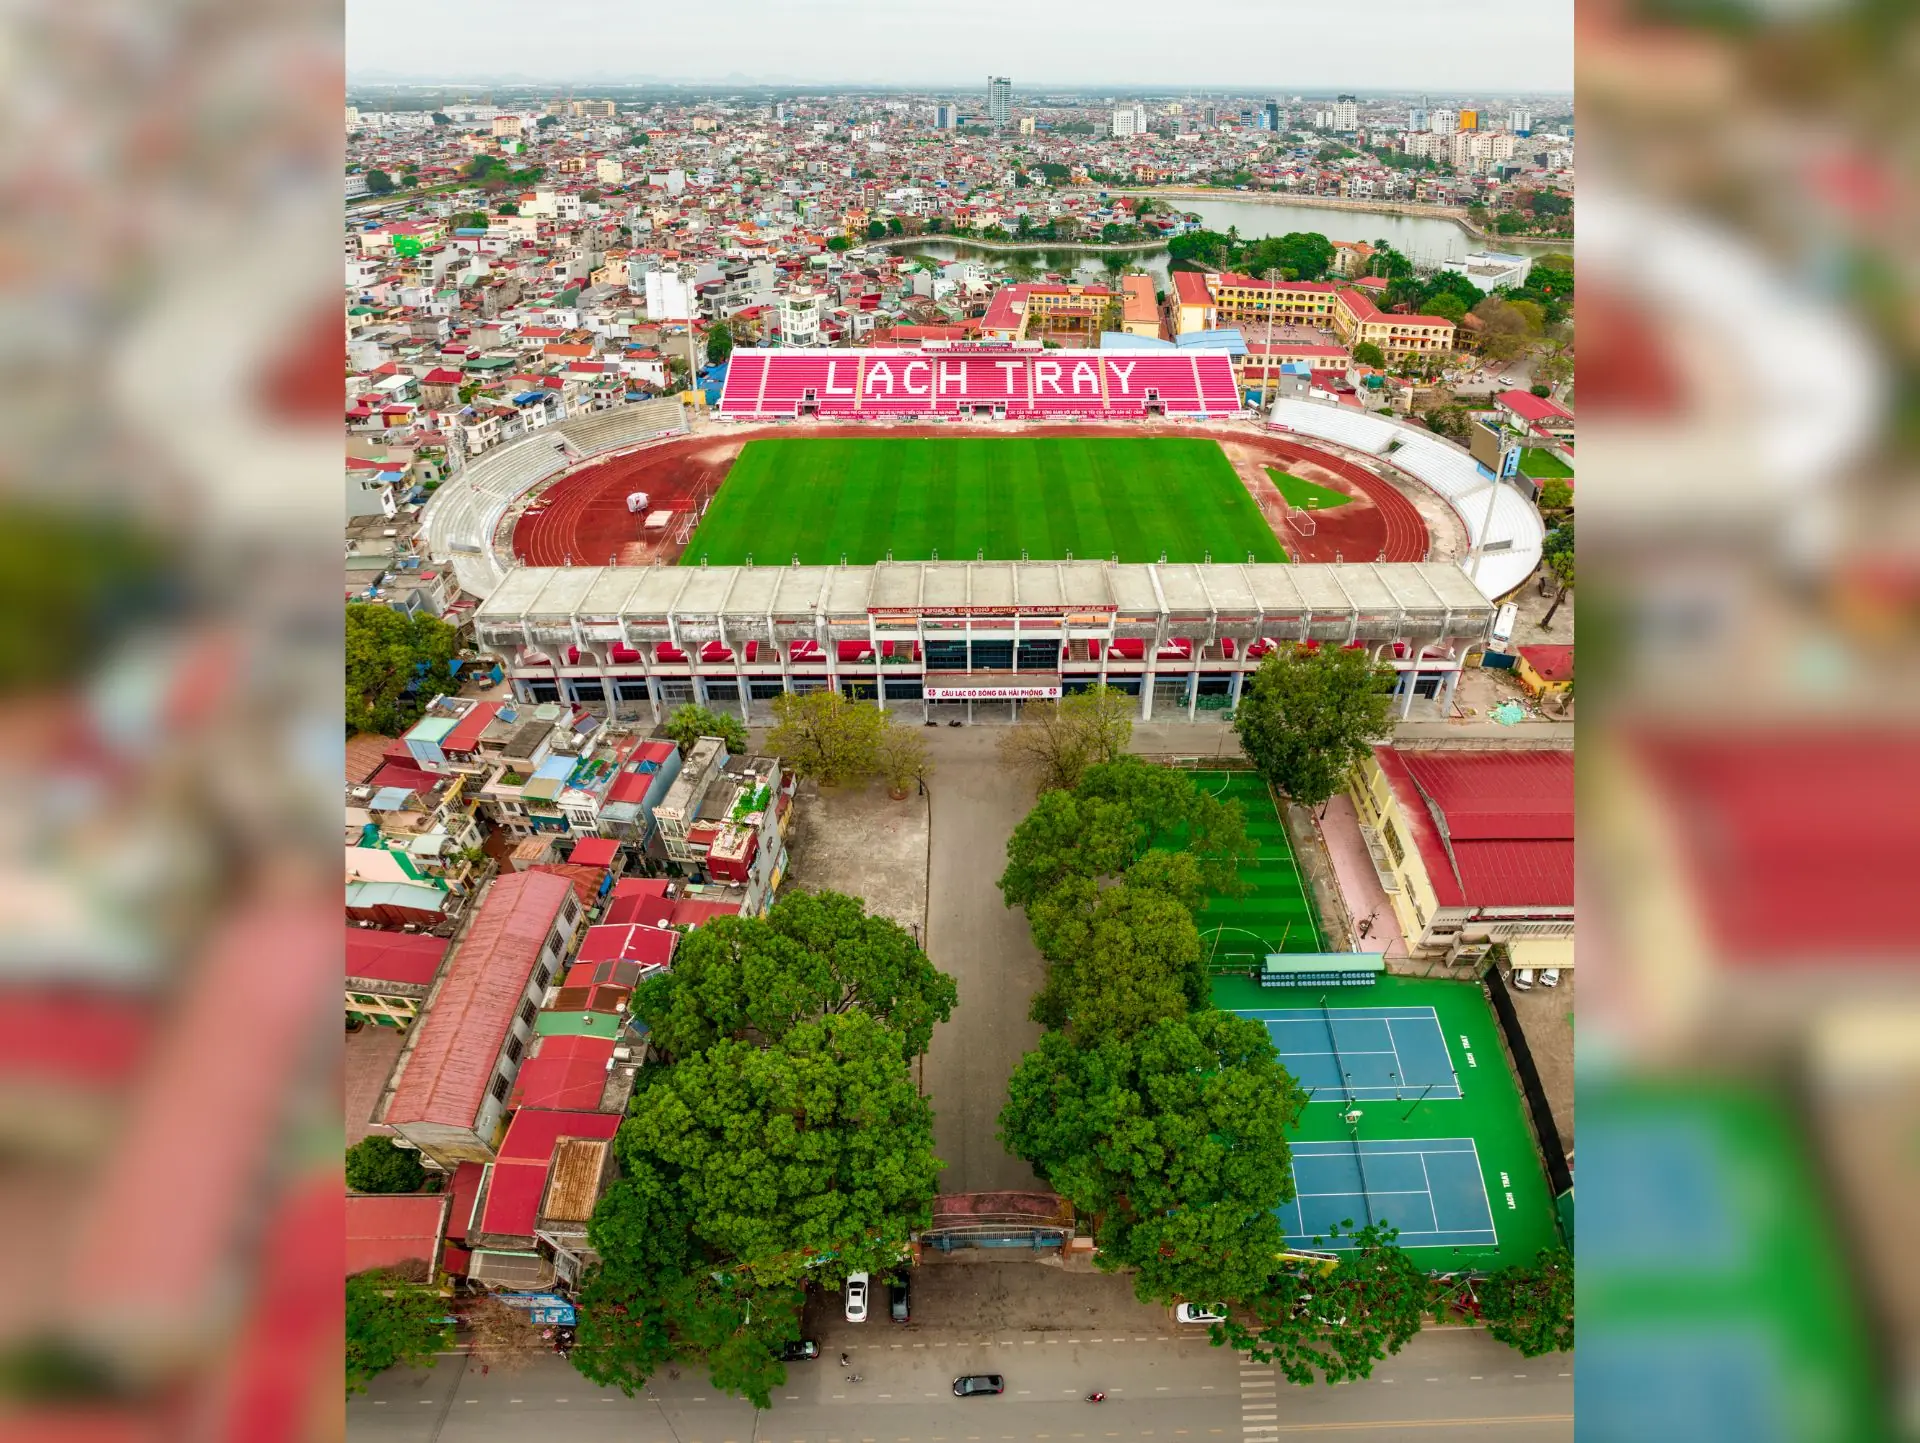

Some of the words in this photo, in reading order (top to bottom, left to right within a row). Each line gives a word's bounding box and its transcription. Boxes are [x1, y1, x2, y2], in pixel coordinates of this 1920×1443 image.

[825, 361, 967, 399] LẠCH
[995, 361, 1137, 395] TRAY
[941, 689, 954, 697] CÂU
[978, 689, 997, 697] BÓNG
